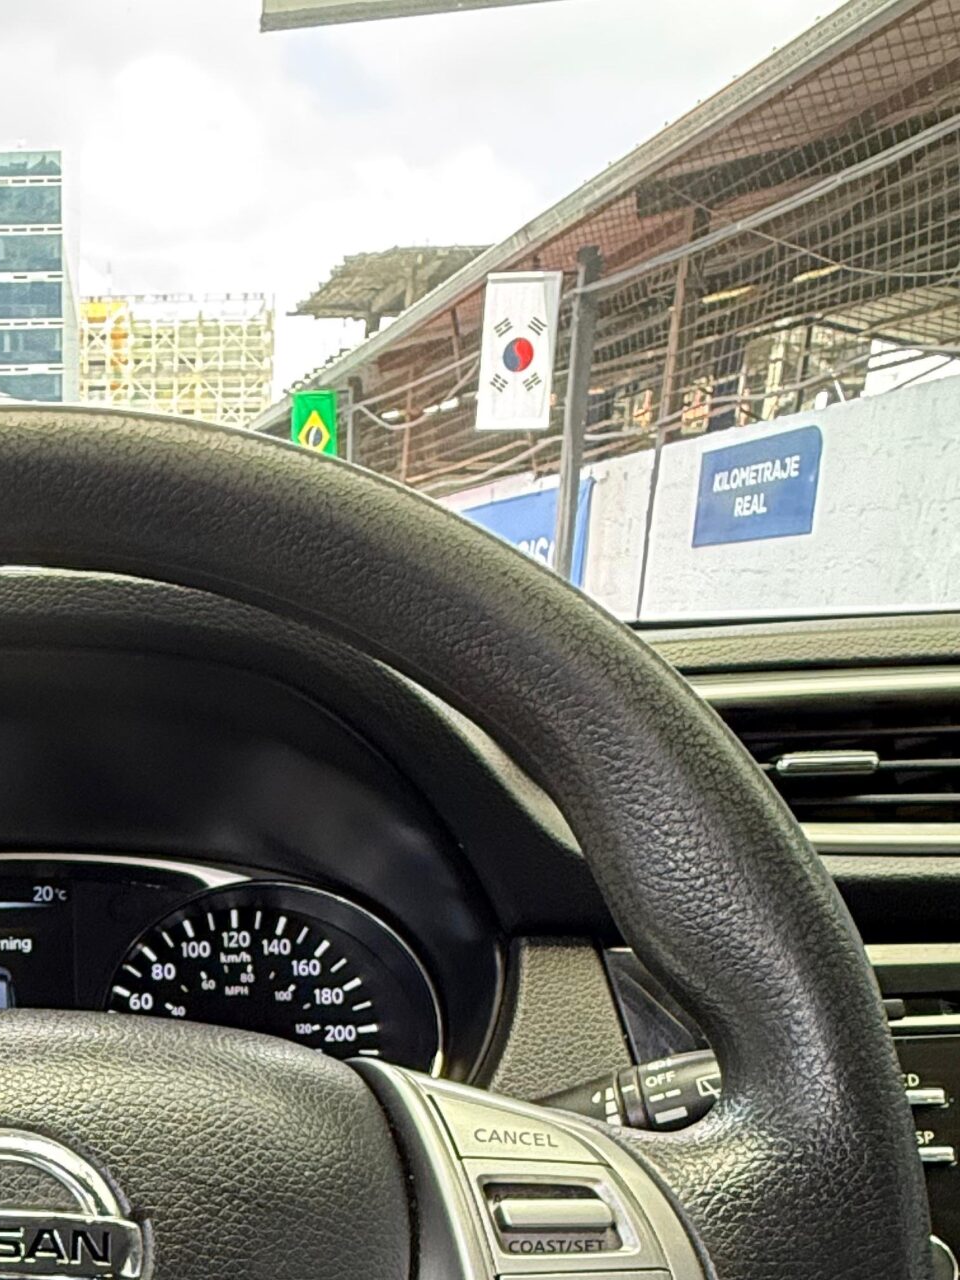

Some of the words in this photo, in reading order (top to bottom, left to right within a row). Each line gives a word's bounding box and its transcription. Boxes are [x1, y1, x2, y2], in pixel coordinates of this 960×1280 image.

[712, 455, 800, 492] KILOMETRAJE
[733, 495, 768, 518] REAL
[222, 931, 251, 948] 120
[262, 938, 291, 956] 140
[181, 941, 211, 959] 100
[220, 951, 251, 964] km/h
[151, 963, 176, 981] 80
[291, 959, 321, 977] 160
[201, 979, 216, 991] 60
[240, 972, 255, 984] 80
[224, 985, 249, 997] MPH
[274, 990, 292, 1002] 100
[314, 987, 344, 1006] 180
[129, 993, 153, 1011] 60
[171, 1005, 186, 1018] 40
[295, 1023, 313, 1035] 120
[324, 1024, 357, 1043] 200
[644, 1070, 677, 1088] OFF
[473, 1128, 560, 1148] CANCEL
[508, 1239, 606, 1255] COAST/SET
